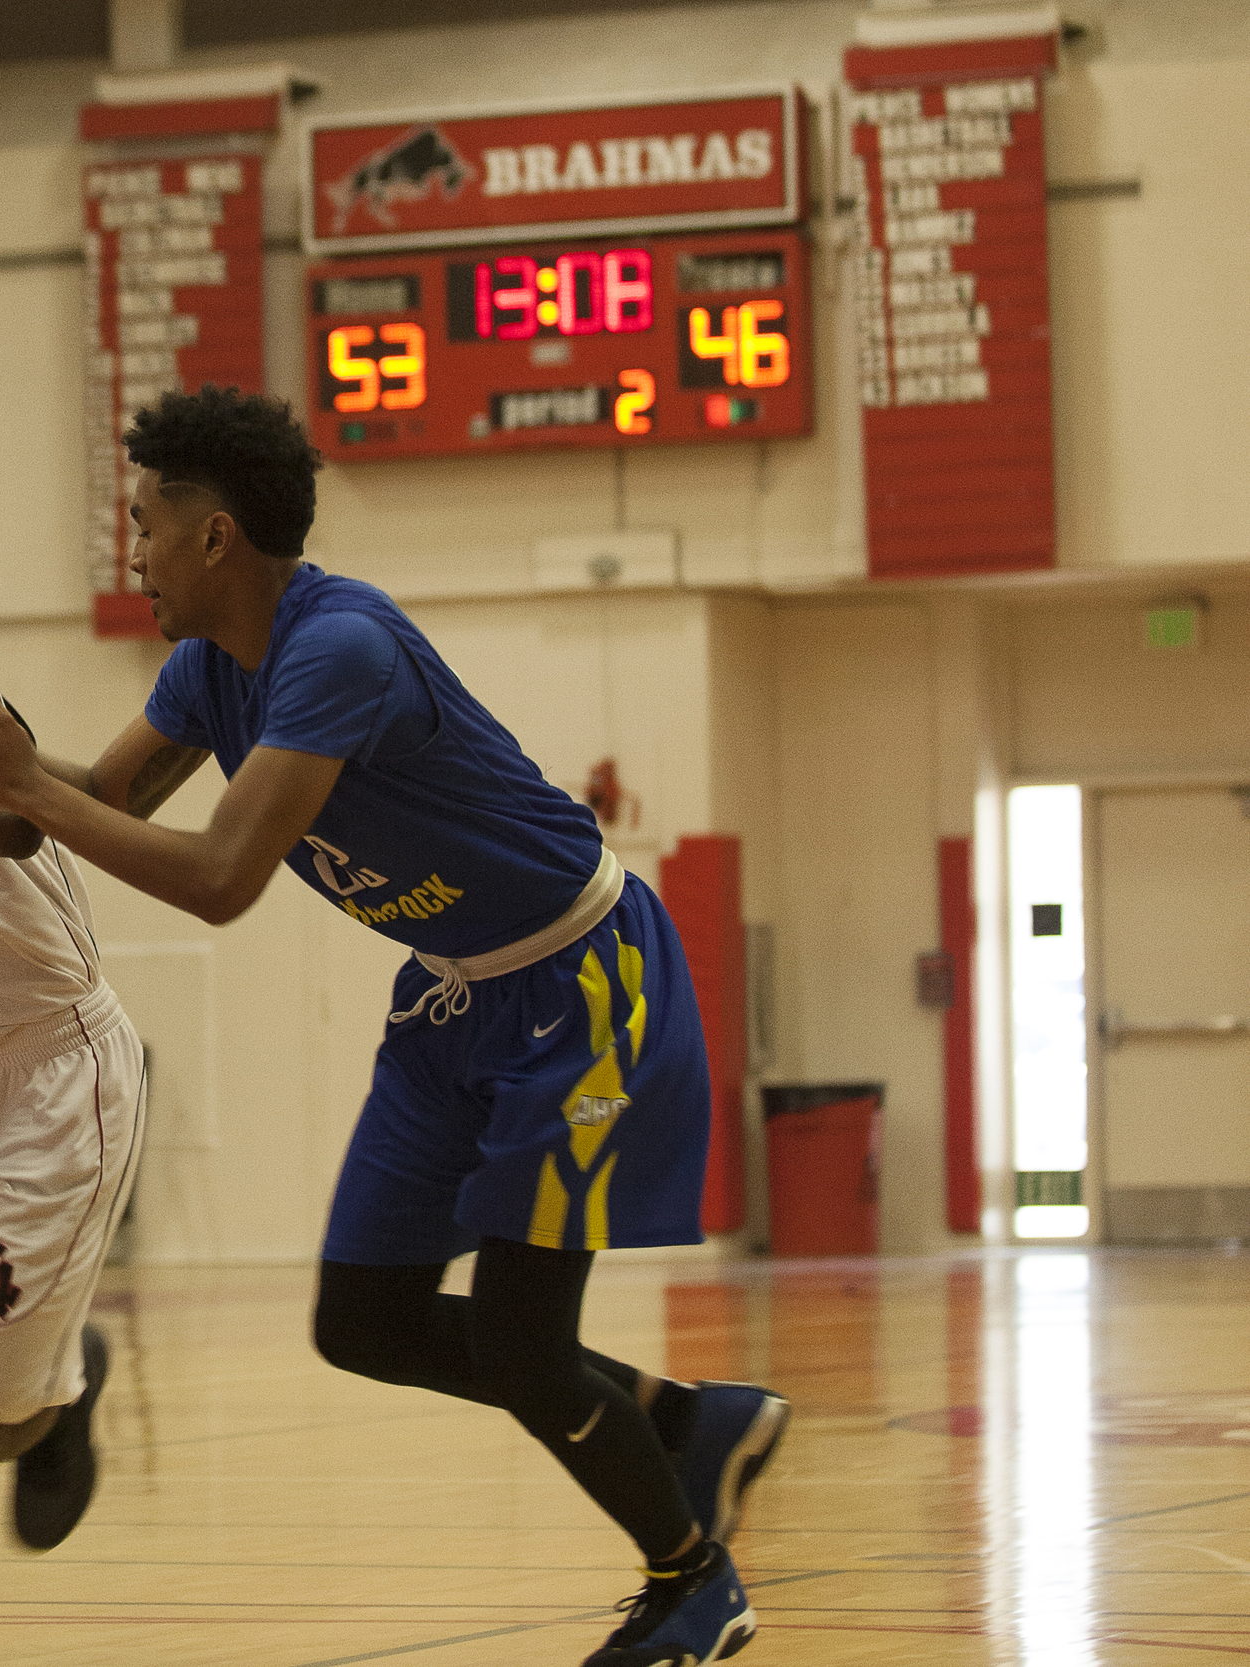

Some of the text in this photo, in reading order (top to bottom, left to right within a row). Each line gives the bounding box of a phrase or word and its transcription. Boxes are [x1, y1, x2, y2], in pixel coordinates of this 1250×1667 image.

[483, 130, 773, 197] BRAHMAS
[475, 249, 653, 341] 13:08
[329, 323, 426, 412] 53
[689, 300, 790, 388] 46
[502, 369, 655, 434] period 2
